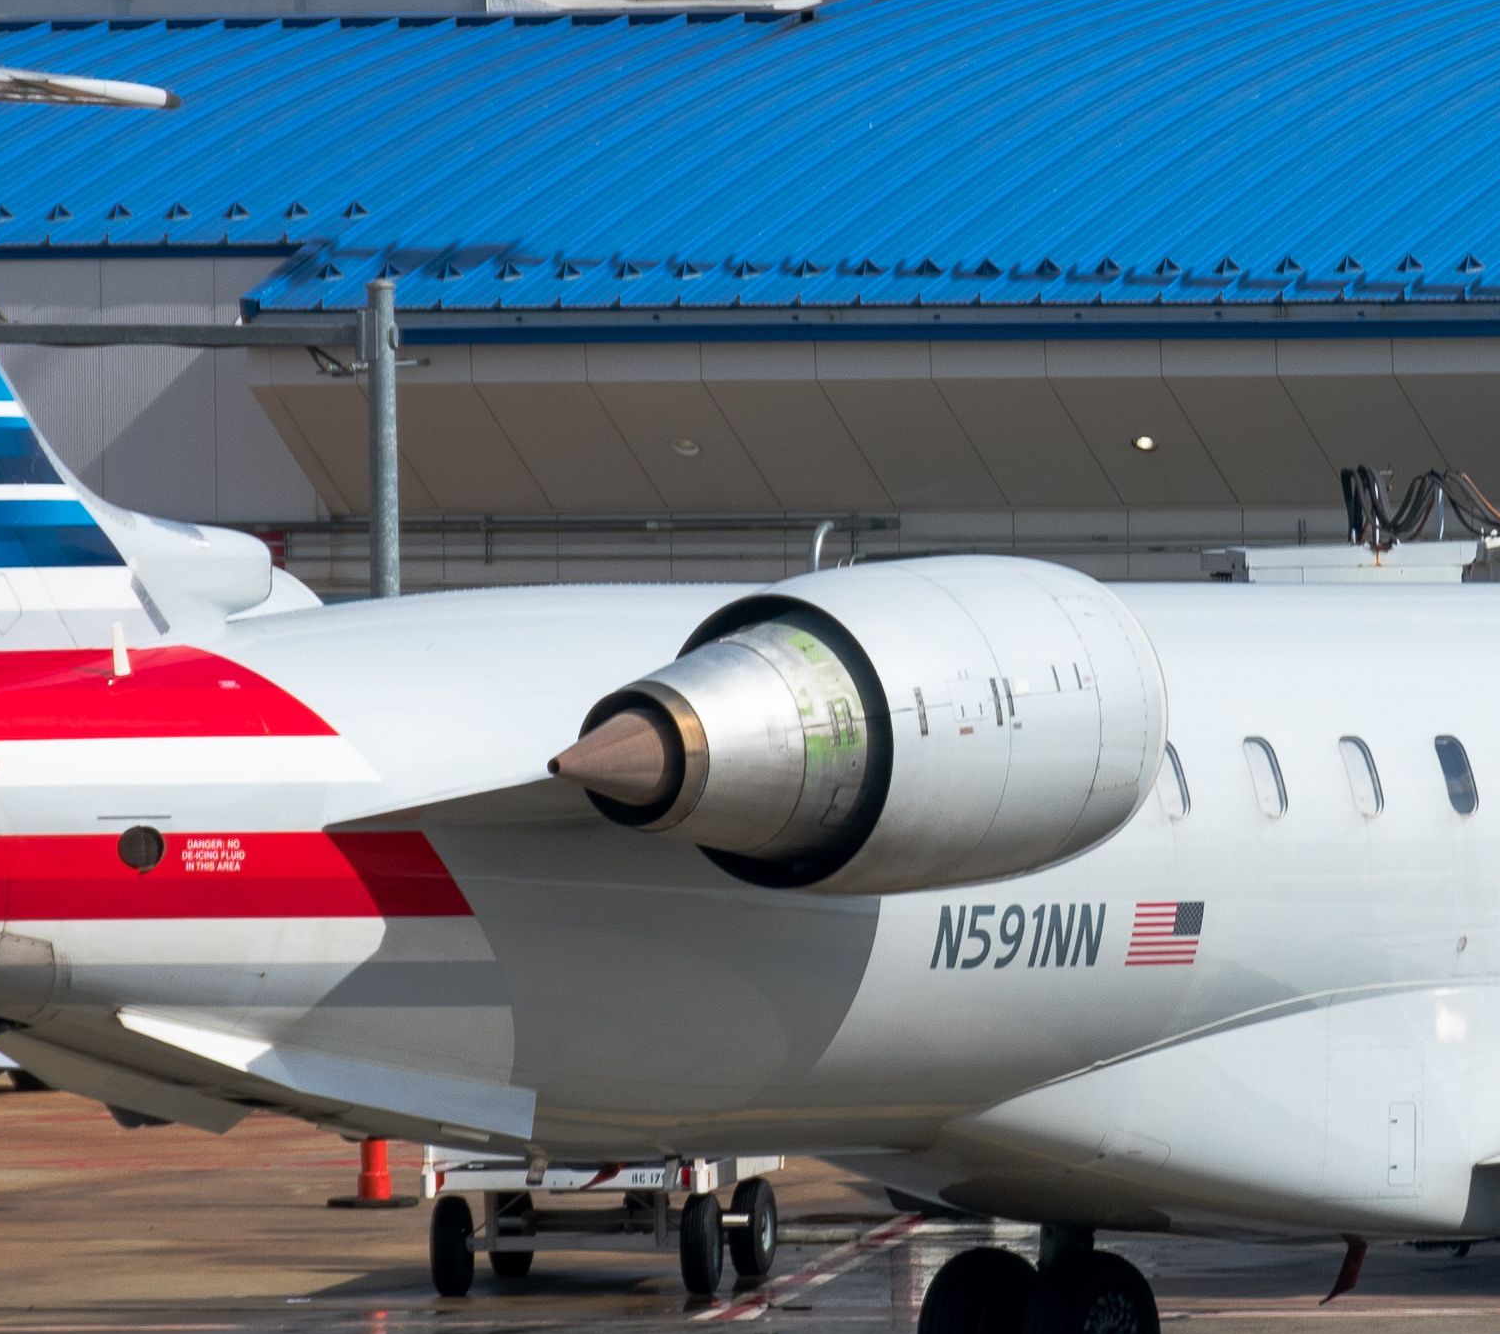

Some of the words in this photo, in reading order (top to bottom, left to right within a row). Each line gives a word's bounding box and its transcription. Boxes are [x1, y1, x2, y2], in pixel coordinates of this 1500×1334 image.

[228, 839, 240, 849] NO
[182, 850, 219, 860] DE-ICING
[221, 850, 245, 860] FLUID
[185, 861, 195, 872] IN
[196, 861, 215, 872] THIS
[217, 861, 241, 872] AREA
[930, 902, 1107, 970] N591NN
